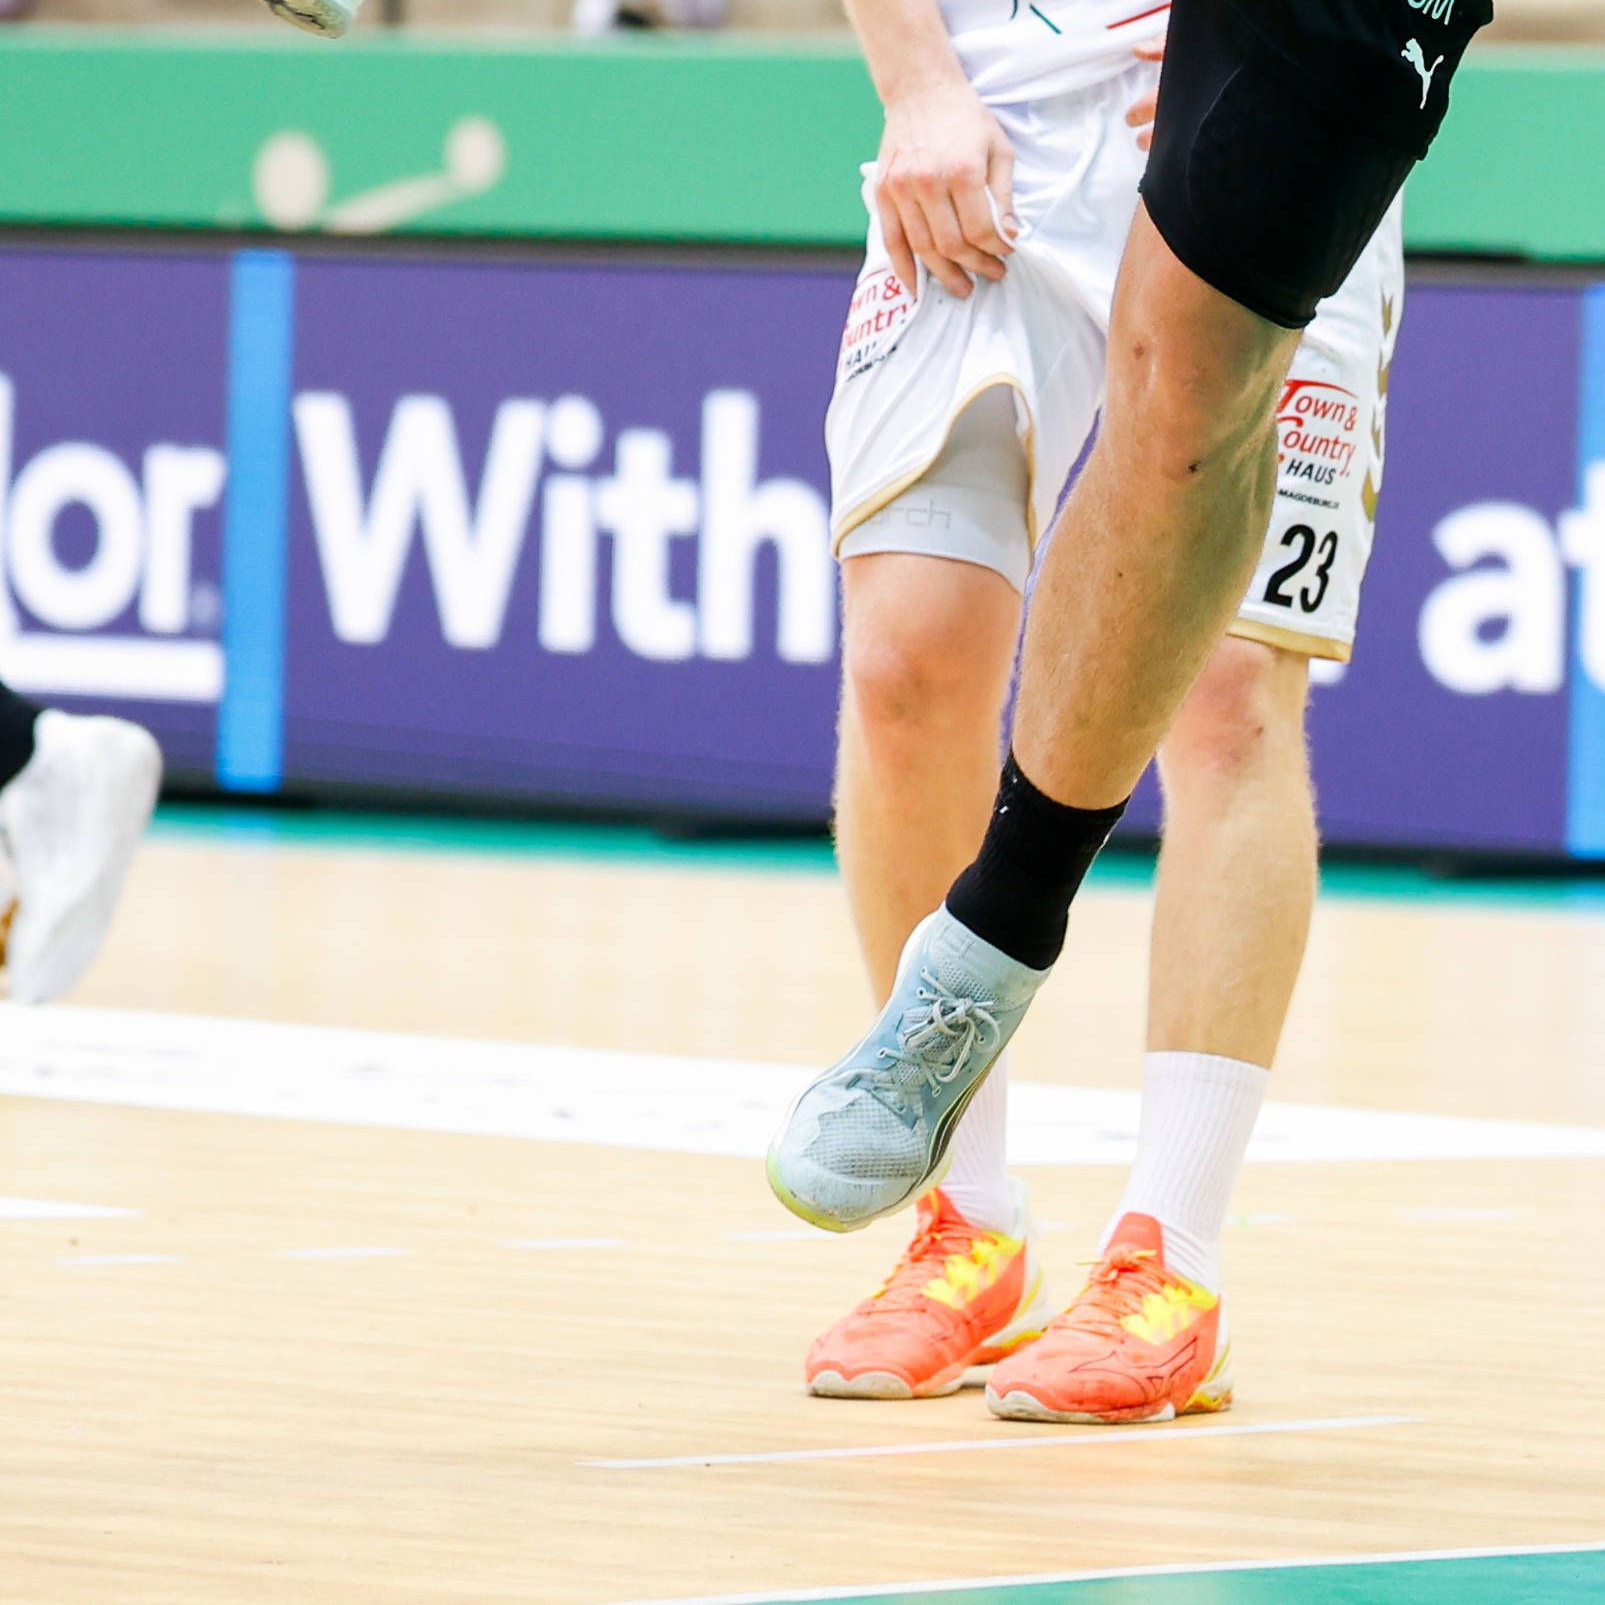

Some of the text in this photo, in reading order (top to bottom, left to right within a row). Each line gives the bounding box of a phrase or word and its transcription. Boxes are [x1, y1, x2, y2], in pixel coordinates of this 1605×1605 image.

[1276, 379, 1358, 433] Town &
[1286, 458, 1337, 485] HAUS
[292, 388, 837, 663] With
[1263, 523, 1339, 614] 23
